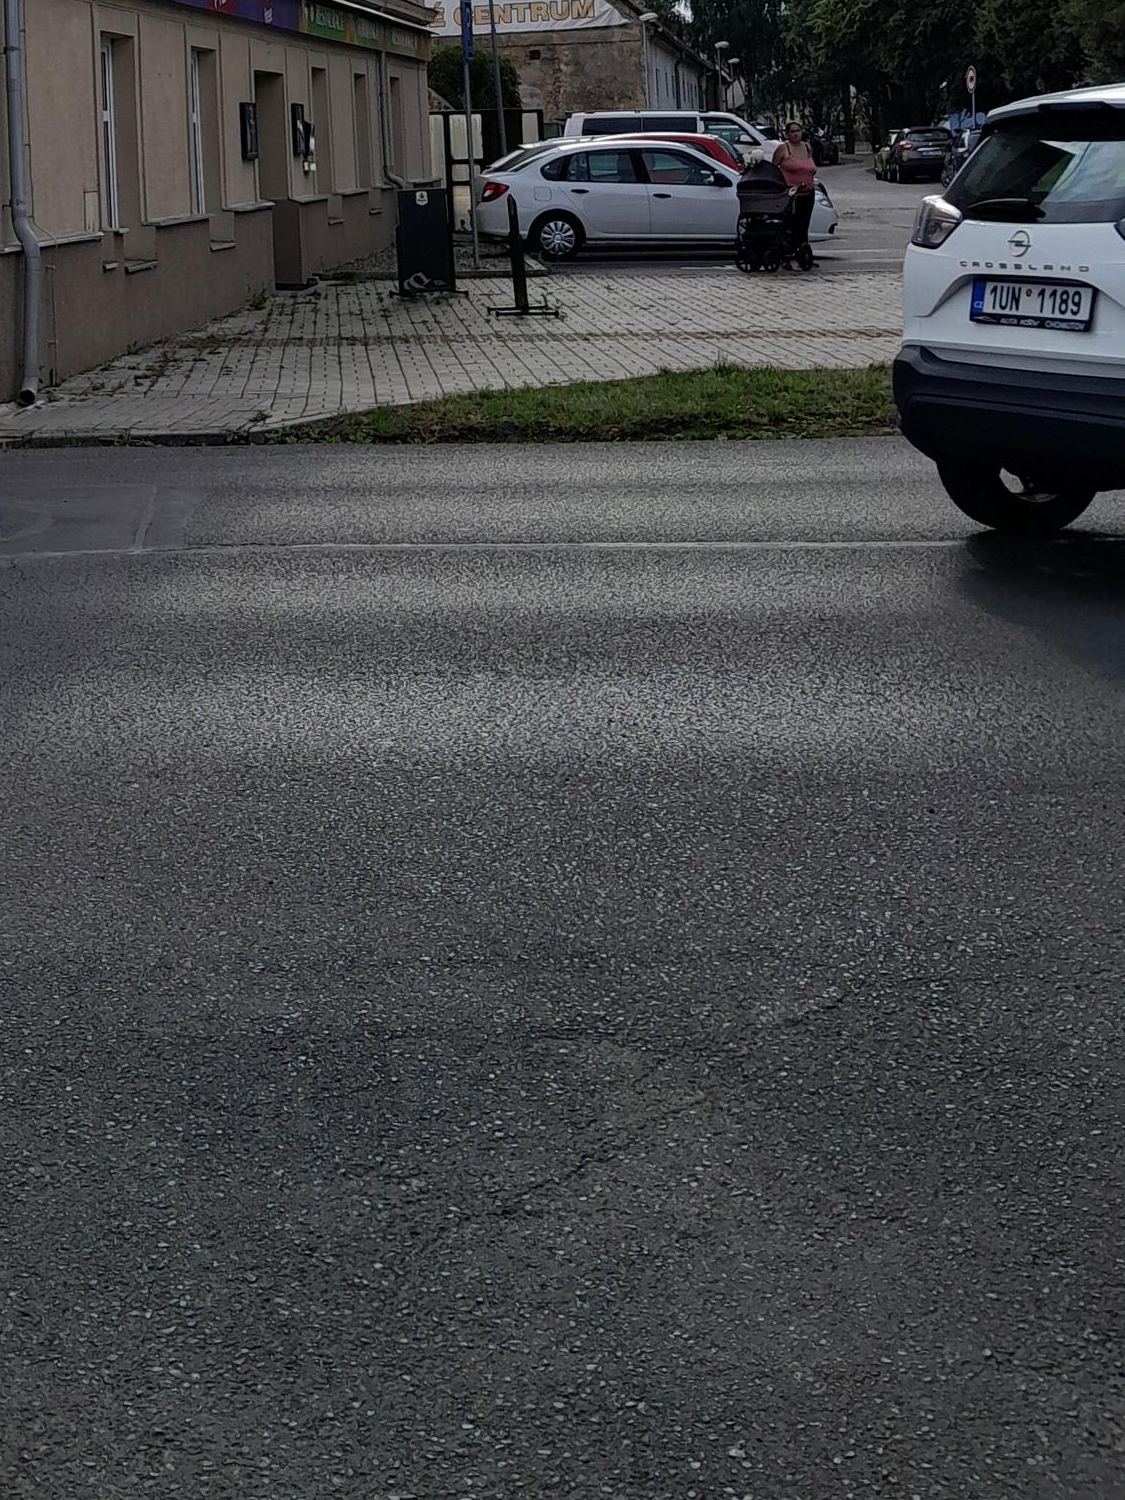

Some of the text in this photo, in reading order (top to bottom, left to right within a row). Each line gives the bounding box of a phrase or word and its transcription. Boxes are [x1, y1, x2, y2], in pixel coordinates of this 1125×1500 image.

[959, 260, 1090, 273] CROSSLAND
[990, 285, 1082, 316] 1UN 1189
